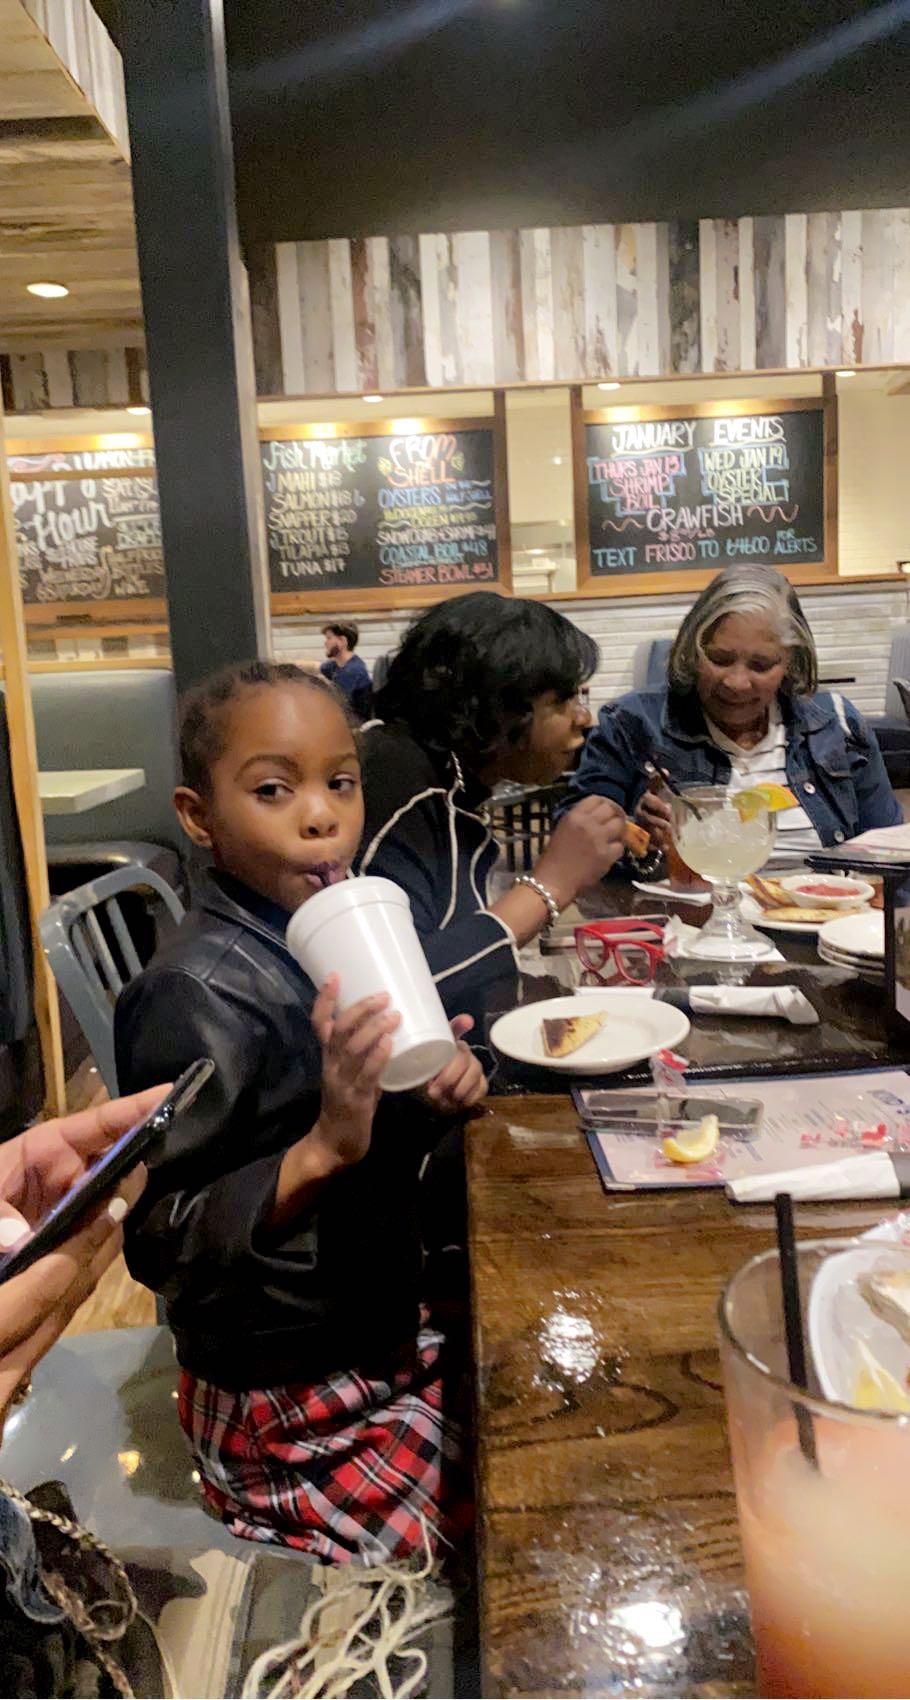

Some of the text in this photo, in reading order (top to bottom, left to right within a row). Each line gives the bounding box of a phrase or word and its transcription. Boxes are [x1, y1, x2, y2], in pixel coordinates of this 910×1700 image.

[612, 416, 785, 451] JANUARY EVENTS
[263, 441, 308, 470] Fish
[389, 435, 457, 473] FROM
[704, 446, 783, 471] WED JAN 19
[387, 460, 457, 488] SHELL
[594, 459, 639, 479] THURS
[708, 467, 762, 492] OYSTER
[278, 471, 316, 493] MAHI
[609, 474, 670, 496] SHRIMP
[271, 491, 331, 514] SALMON
[378, 486, 441, 509] OYSTERS
[625, 493, 660, 513] BOIL
[30, 501, 113, 551] Hour
[268, 509, 331, 533] SNAPPER
[646, 504, 744, 533] CRAWFISH
[279, 527, 326, 545] TROUT
[773, 537, 818, 556] ALERTS
[379, 544, 432, 566] COASTAL
[593, 547, 637, 569] TEXT
[645, 543, 697, 564] FRISCO
[698, 539, 720, 559] TO
[279, 560, 323, 578] TUNA
[378, 566, 437, 585] STEAMER
[438, 563, 474, 583] BOWL
